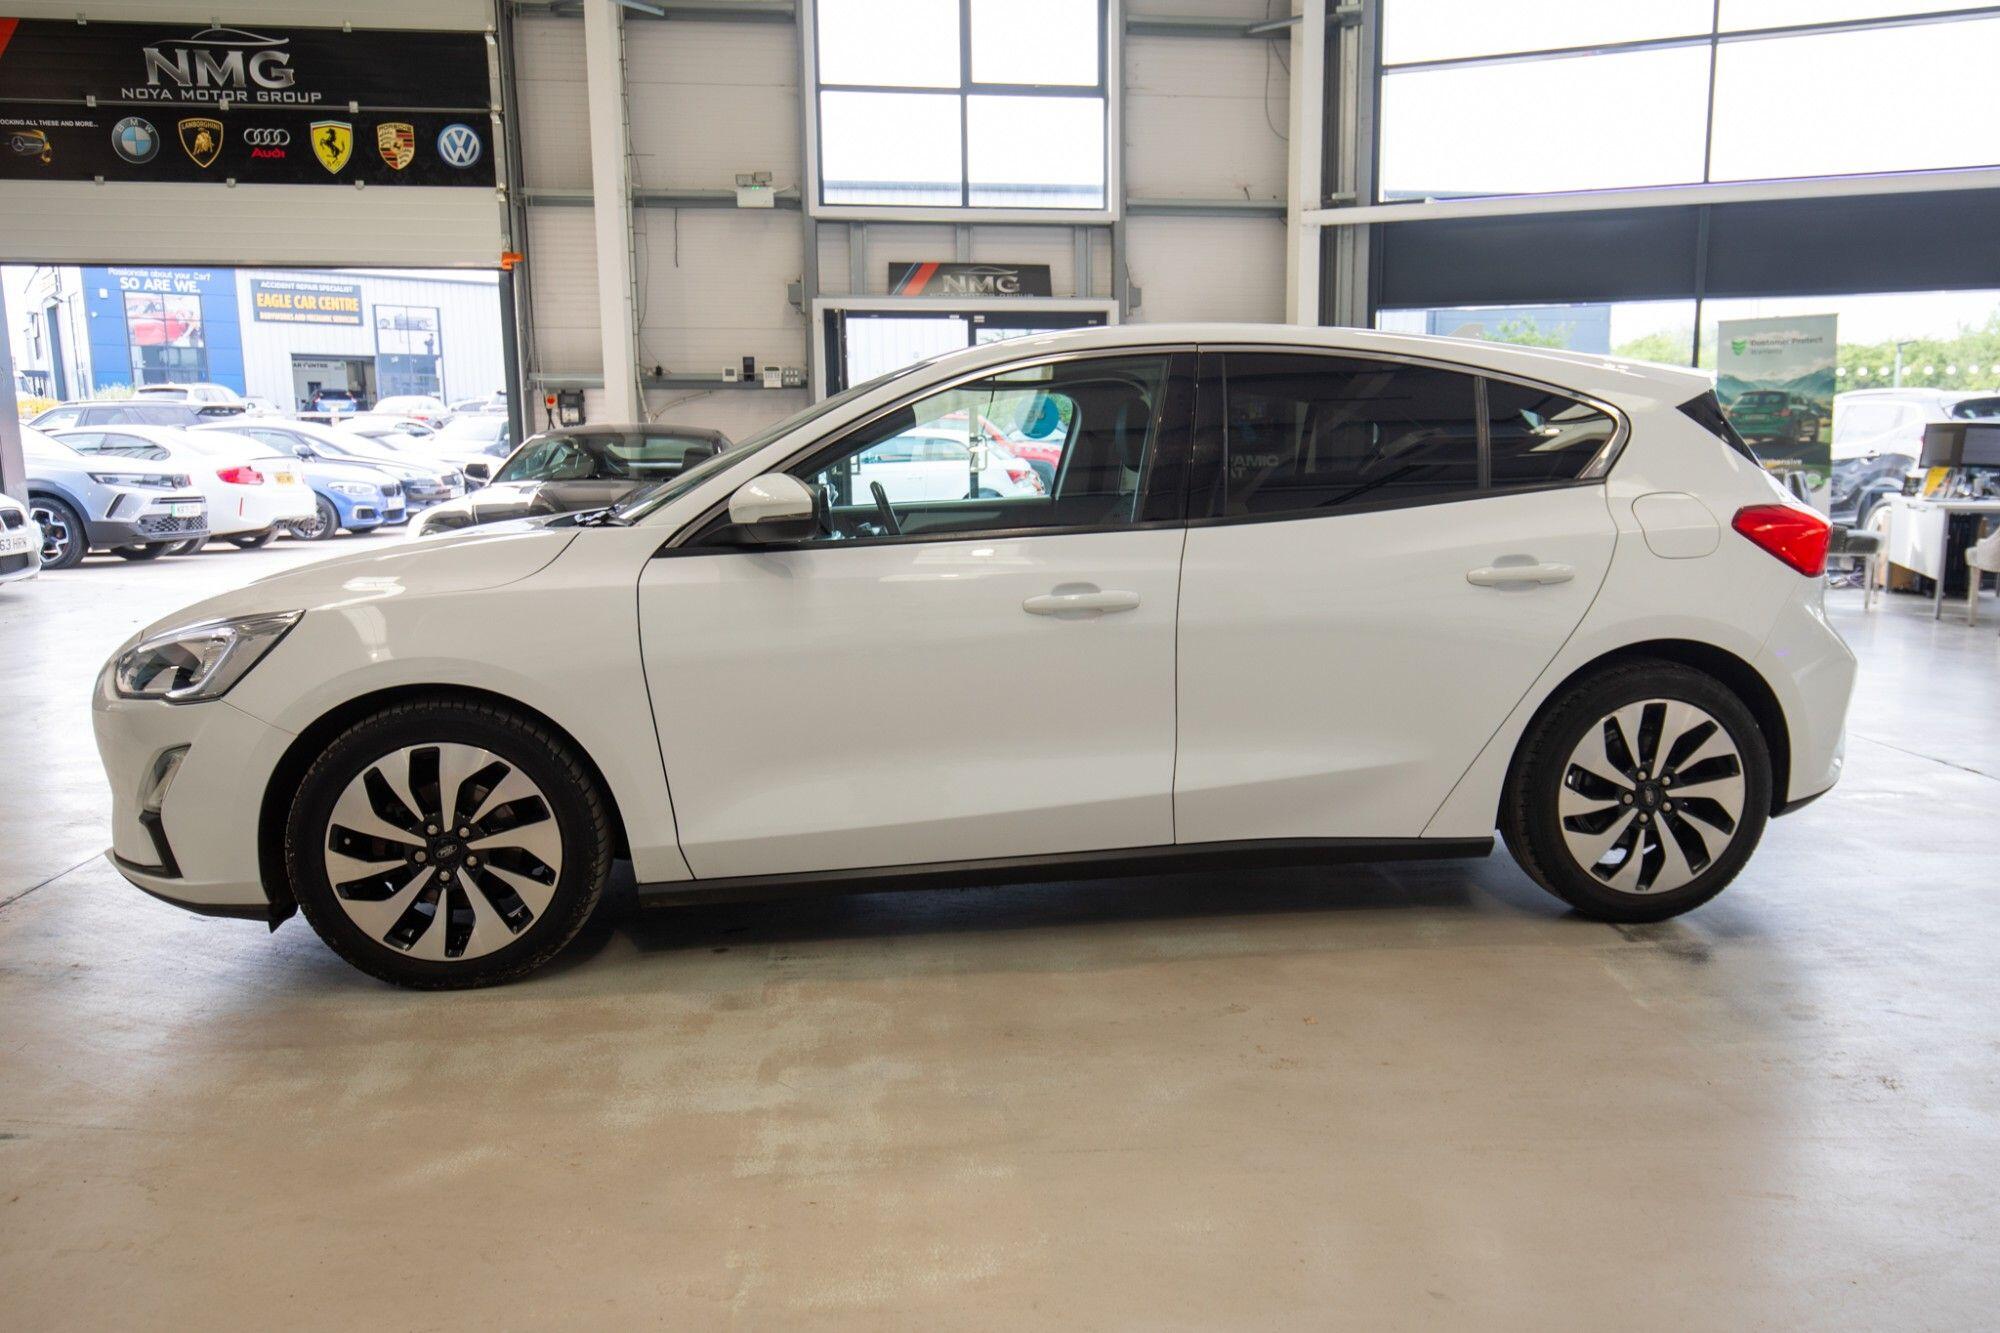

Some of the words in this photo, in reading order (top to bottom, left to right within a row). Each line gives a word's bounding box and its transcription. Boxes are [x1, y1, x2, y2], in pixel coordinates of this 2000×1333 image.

[143, 47, 295, 89] NMG
[121, 87, 173, 100] NOYA
[181, 89, 248, 101] MOTOR
[256, 90, 322, 104] GROUP
[39, 119, 60, 127] THESE
[181, 119, 222, 130] LAMBORGHINI
[251, 147, 286, 159] Audi
[120, 276, 140, 290] SO
[144, 278, 171, 292] ARE
[173, 280, 201, 293] WE.
[942, 274, 1020, 293] NMG
[256, 292, 292, 309] EAGLE
[293, 294, 318, 310] CAR
[318, 296, 360, 312] CENTRE
